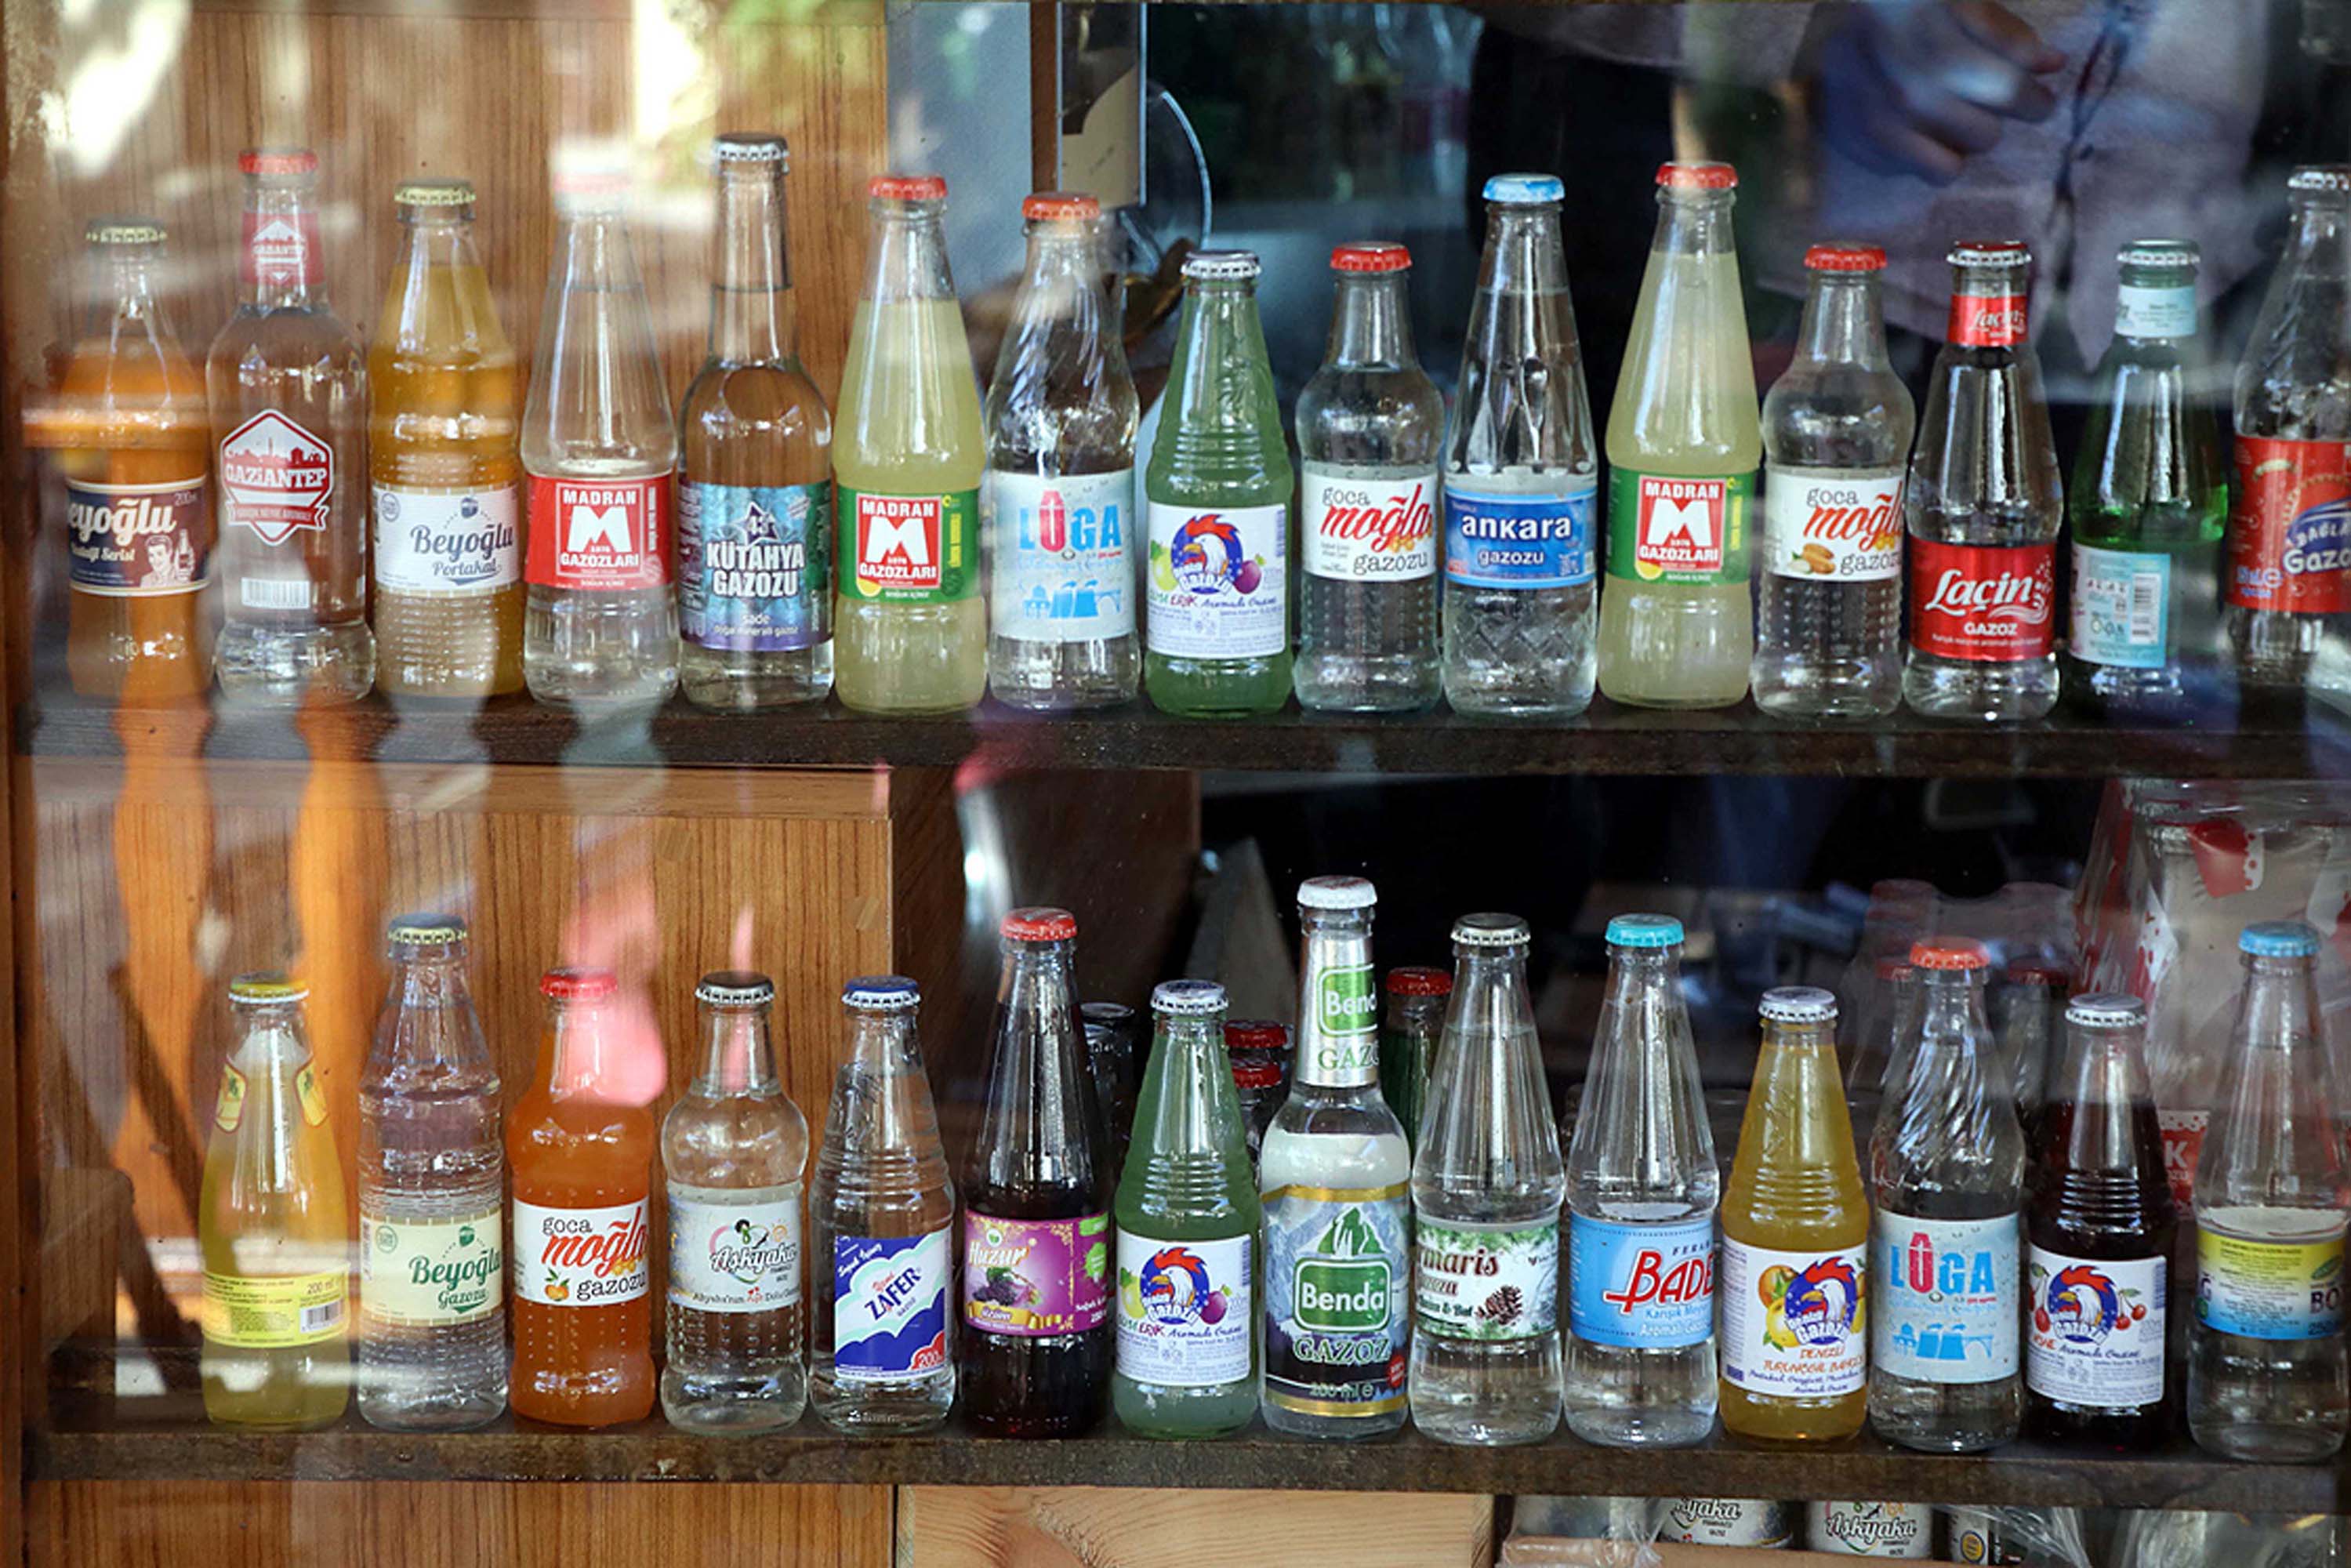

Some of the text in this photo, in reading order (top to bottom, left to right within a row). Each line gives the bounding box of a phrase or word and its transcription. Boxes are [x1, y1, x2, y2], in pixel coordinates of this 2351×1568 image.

[562, 488, 637, 506] MADRAN
[1322, 478, 1371, 507] goca
[1645, 481, 1719, 499] MADRAN
[1806, 487, 1859, 508] goca
[862, 499, 934, 517] MADRAN
[1802, 480, 1903, 552] moğl
[67, 496, 178, 546] eyoğlu
[1462, 514, 1572, 541] ankara
[561, 553, 640, 568] GAZOZLARI
[1352, 551, 1428, 576] gazozu
[1478, 550, 1544, 568] gazozu
[1639, 545, 1718, 561] GAZOZLARI
[859, 562, 938, 579] GAZOZLARI
[713, 570, 799, 598] GAZOZU
[1925, 568, 2034, 617] Laçin
[1963, 621, 2019, 637] GAZOZ
[542, 1216, 593, 1236] goca
[863, 1265, 923, 1322] ZAFER
[1301, 1282, 1385, 1312] Benda
[1293, 1338, 1391, 1365] GAZOZ
